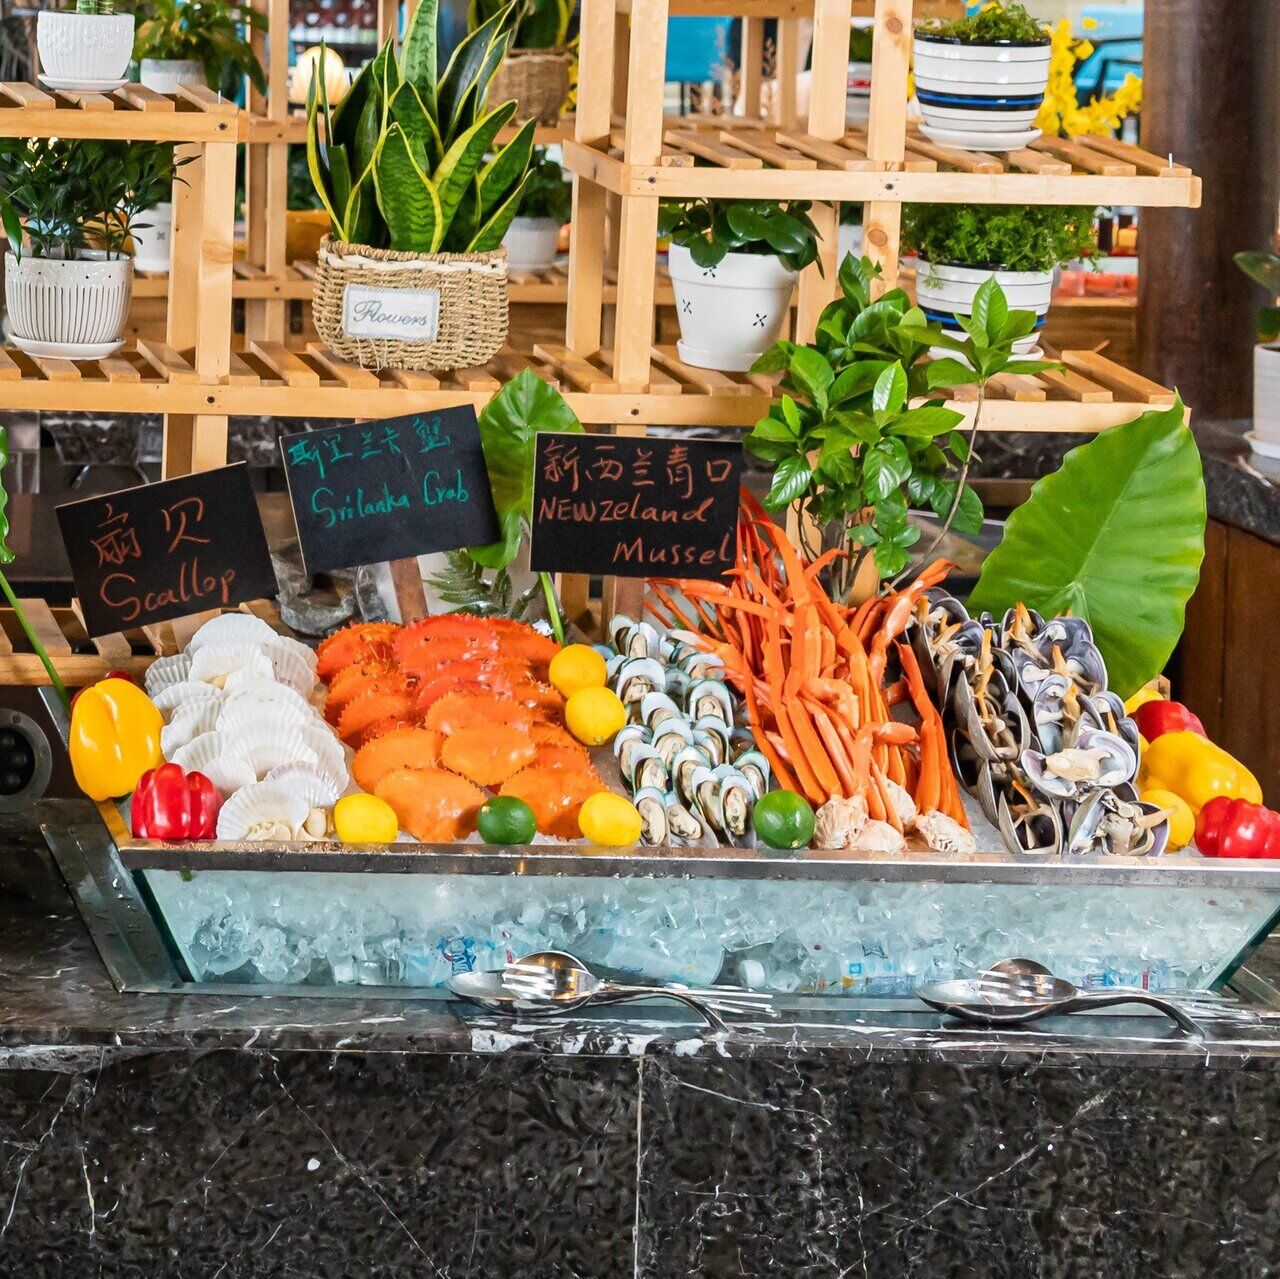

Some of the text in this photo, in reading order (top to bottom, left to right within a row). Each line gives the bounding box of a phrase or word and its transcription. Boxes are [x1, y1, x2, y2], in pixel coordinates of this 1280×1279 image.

[354, 300, 428, 327] Flowers
[423, 469, 469, 505] Crab
[543, 439, 733, 499] 新西兰青口
[90, 496, 211, 567] 扇贝
[612, 531, 731, 565] Mussel
[100, 557, 236, 621] Scallop
